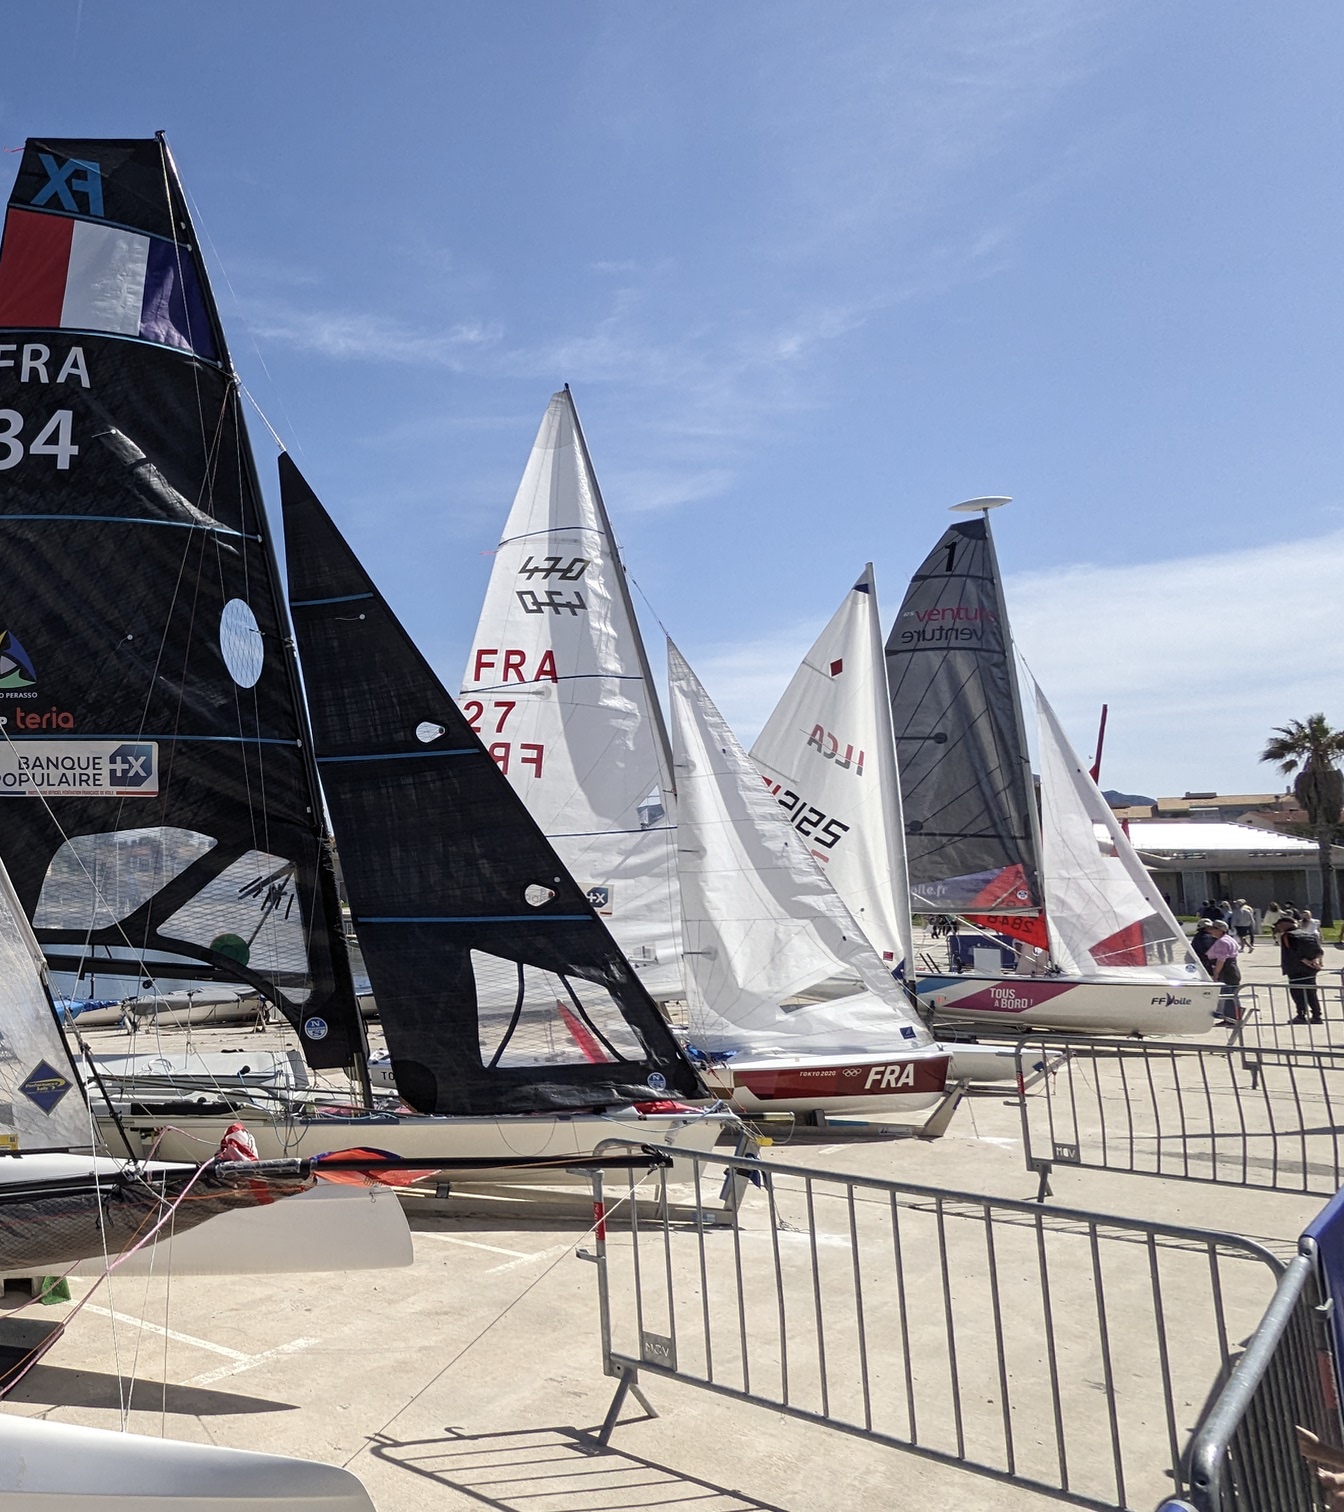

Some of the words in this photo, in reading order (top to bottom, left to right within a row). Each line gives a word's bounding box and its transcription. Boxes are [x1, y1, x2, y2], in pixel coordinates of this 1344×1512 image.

[945, 541, 957, 572] 1
[473, 649, 558, 684] FRA
[5, 691, 38, 699] PERASSO
[16, 706, 74, 730] teria
[463, 701, 516, 733] 27
[18, 756, 103, 771] BANQUE
[990, 988, 1016, 999] TOUS
[1001, 998, 1028, 1009] BORD
[864, 1063, 914, 1090] FRA
